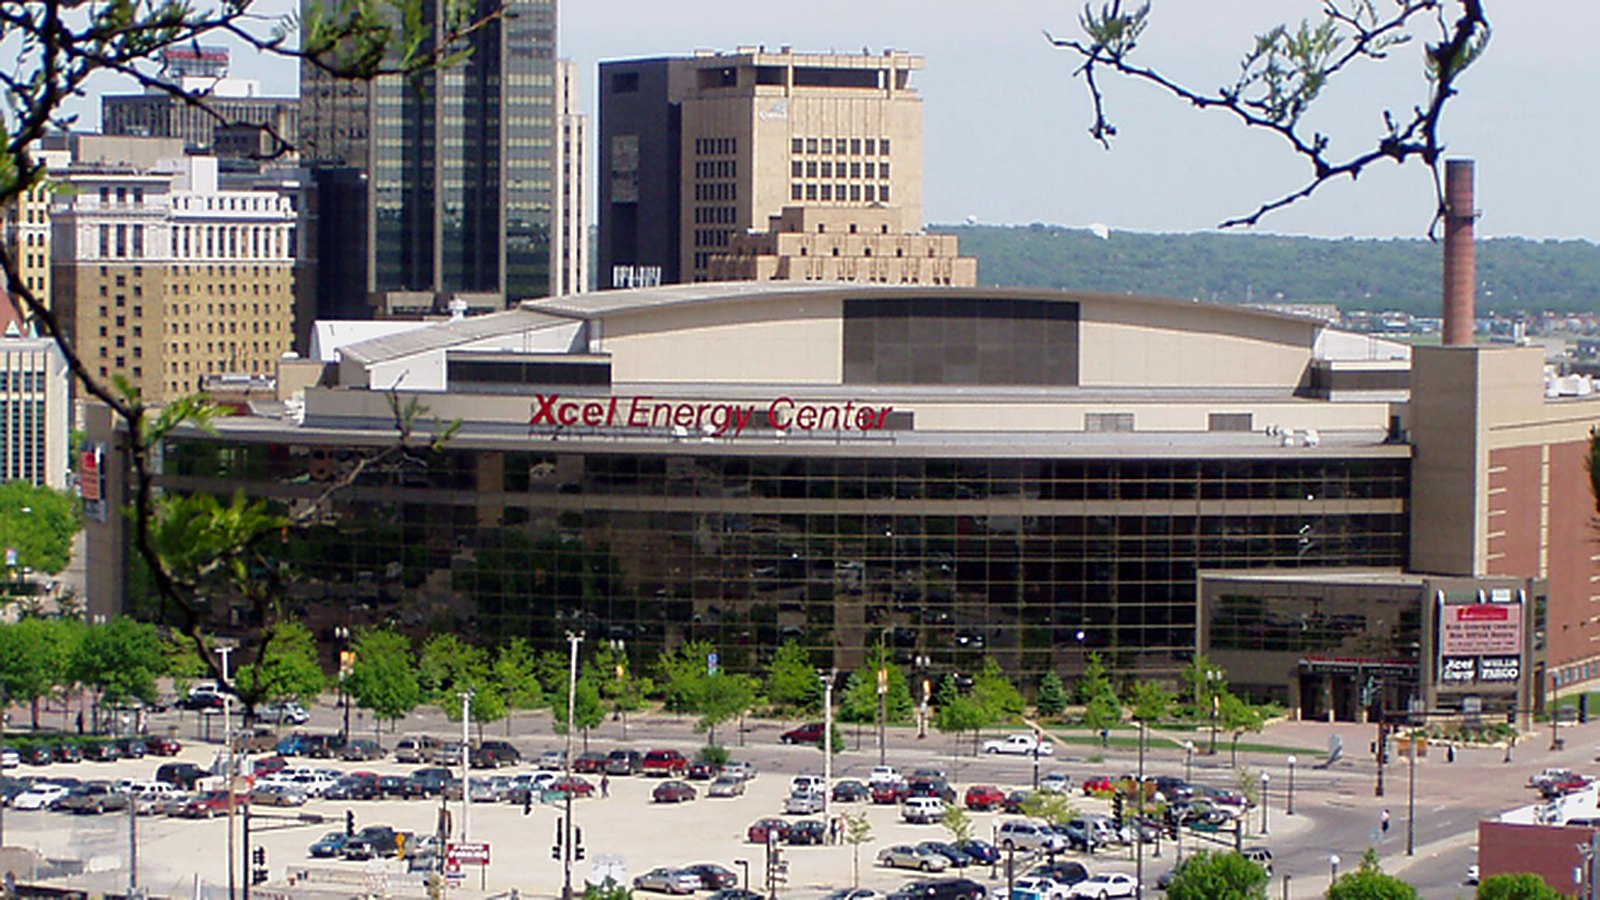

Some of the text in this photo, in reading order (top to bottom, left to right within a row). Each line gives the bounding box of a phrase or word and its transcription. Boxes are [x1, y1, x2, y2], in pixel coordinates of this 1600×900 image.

[530, 394, 893, 437] Xcel Energy Center
